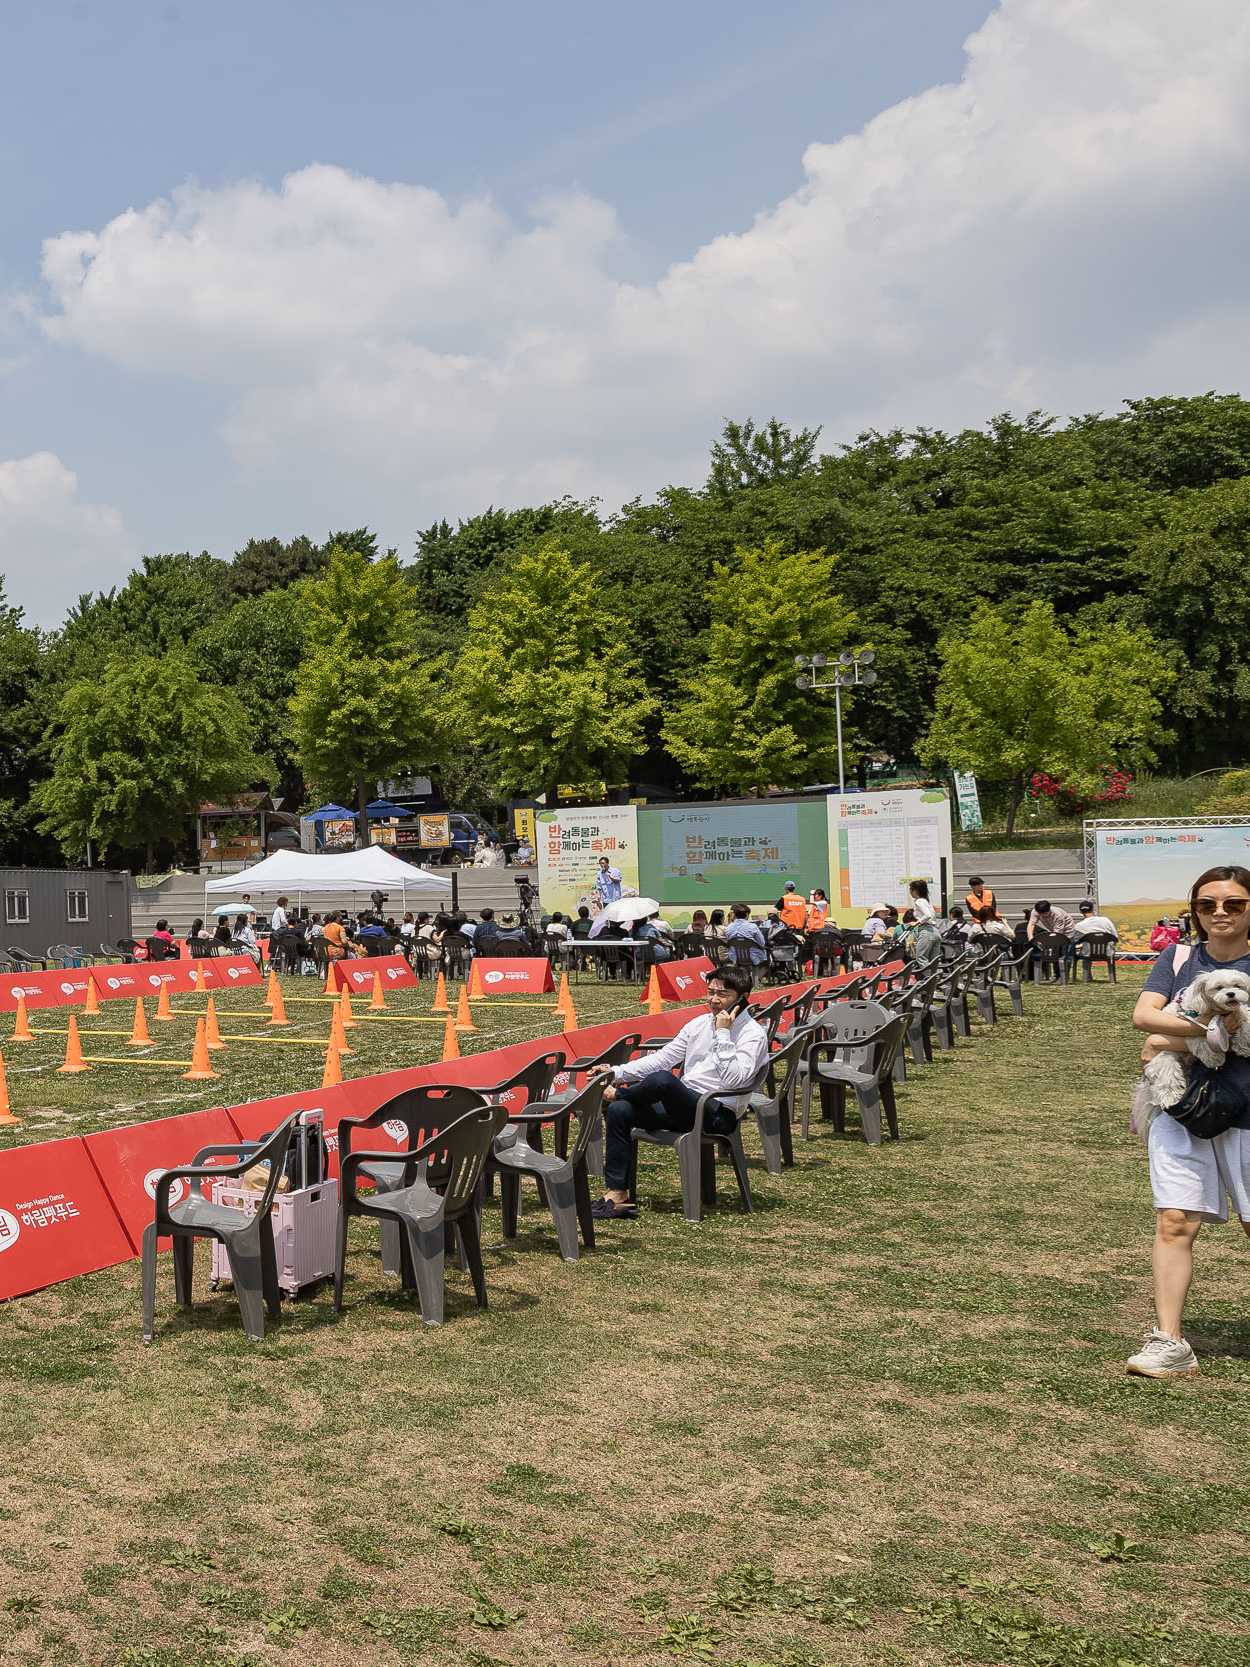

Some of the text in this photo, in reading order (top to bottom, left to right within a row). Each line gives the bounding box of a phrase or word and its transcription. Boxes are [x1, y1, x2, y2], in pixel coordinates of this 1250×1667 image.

[548, 824, 599, 839] 반려동물과
[686, 833, 756, 850] 반려동물과
[15, 1193, 65, 1211] Design Happy Dance
[21, 1201, 80, 1229] 하림펫푸드
